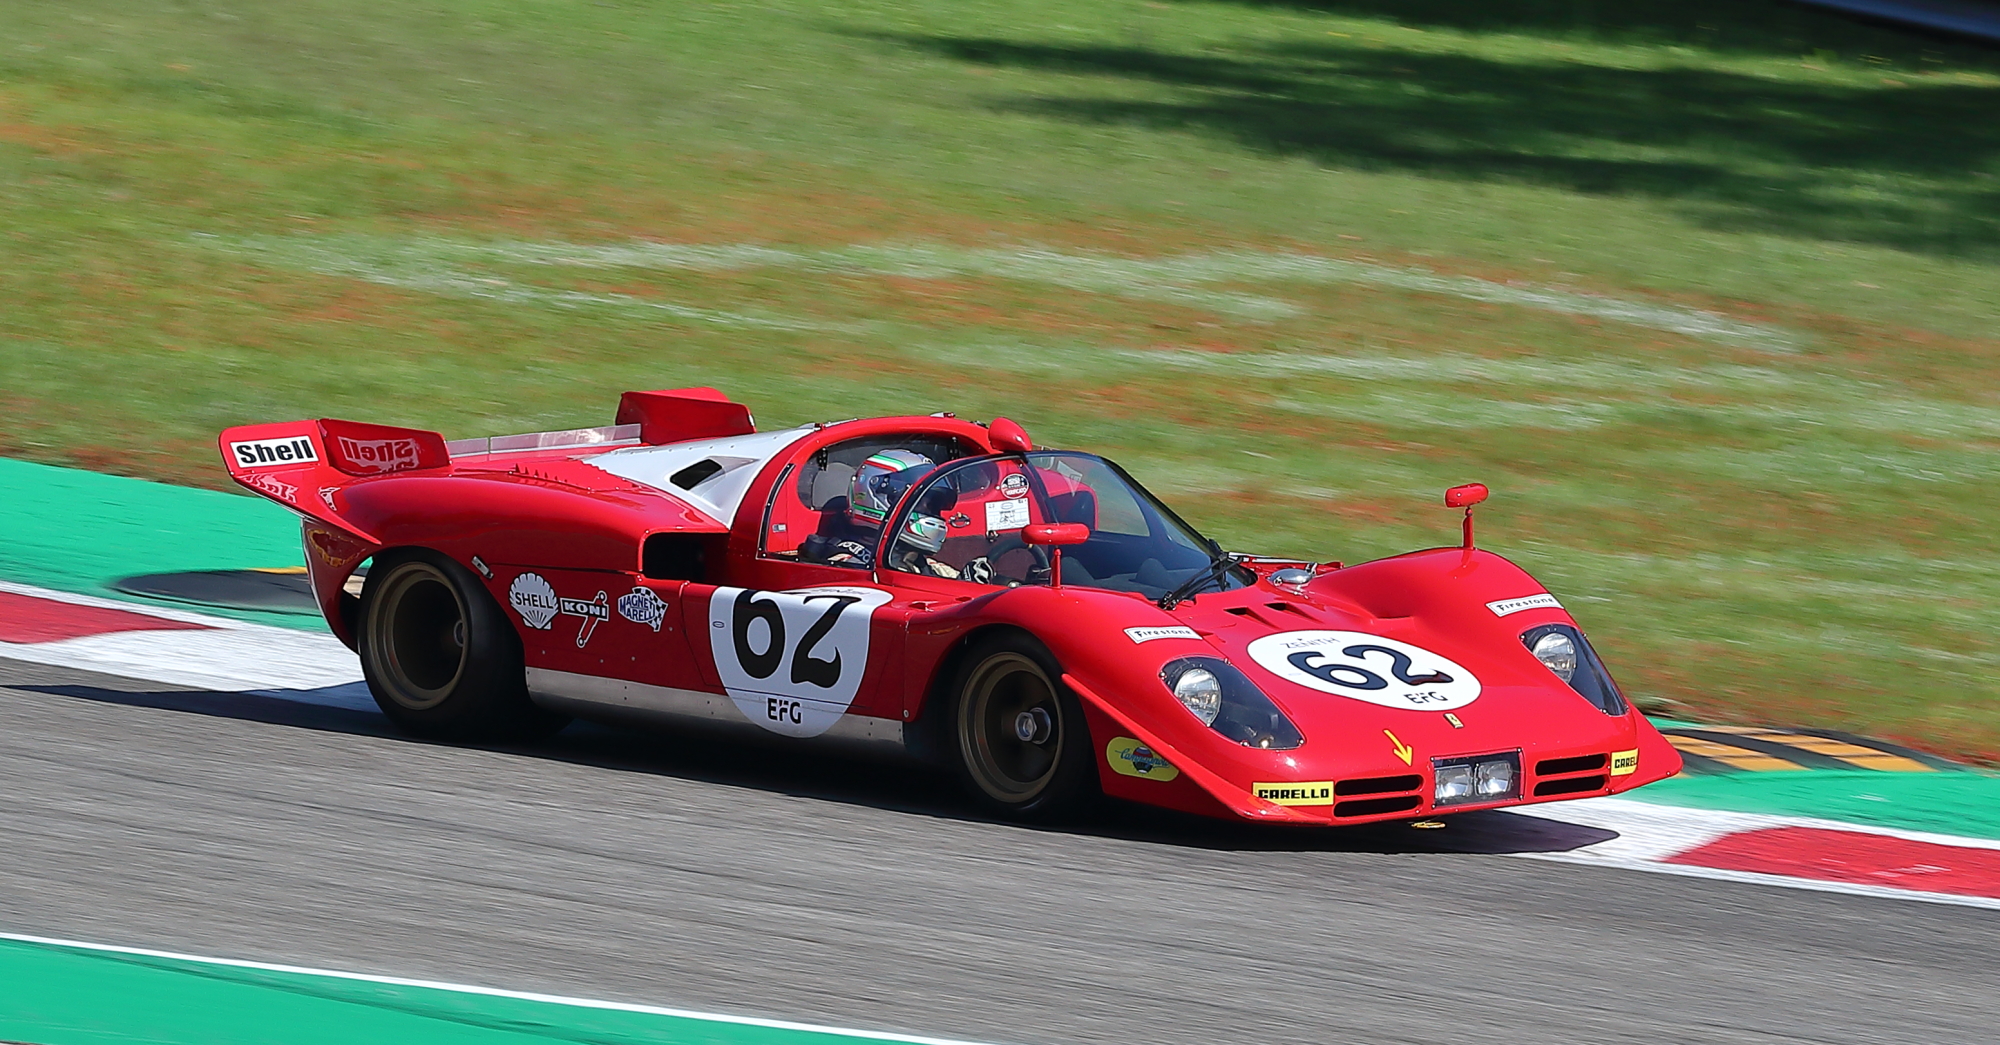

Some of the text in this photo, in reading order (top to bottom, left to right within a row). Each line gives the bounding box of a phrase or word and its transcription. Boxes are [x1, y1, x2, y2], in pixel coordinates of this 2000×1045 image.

[236, 439, 315, 465] Shell
[514, 592, 554, 609] SHELL
[1495, 597, 1555, 612] Firestone
[563, 602, 607, 618] KONI
[732, 589, 862, 688] 62
[1134, 629, 1192, 637] Firestone
[1280, 637, 1341, 649] ZENITH
[1287, 644, 1455, 690] 62
[1403, 691, 1449, 704] EFG
[767, 697, 802, 724] EFG
[1258, 788, 1330, 799] CARELLO
